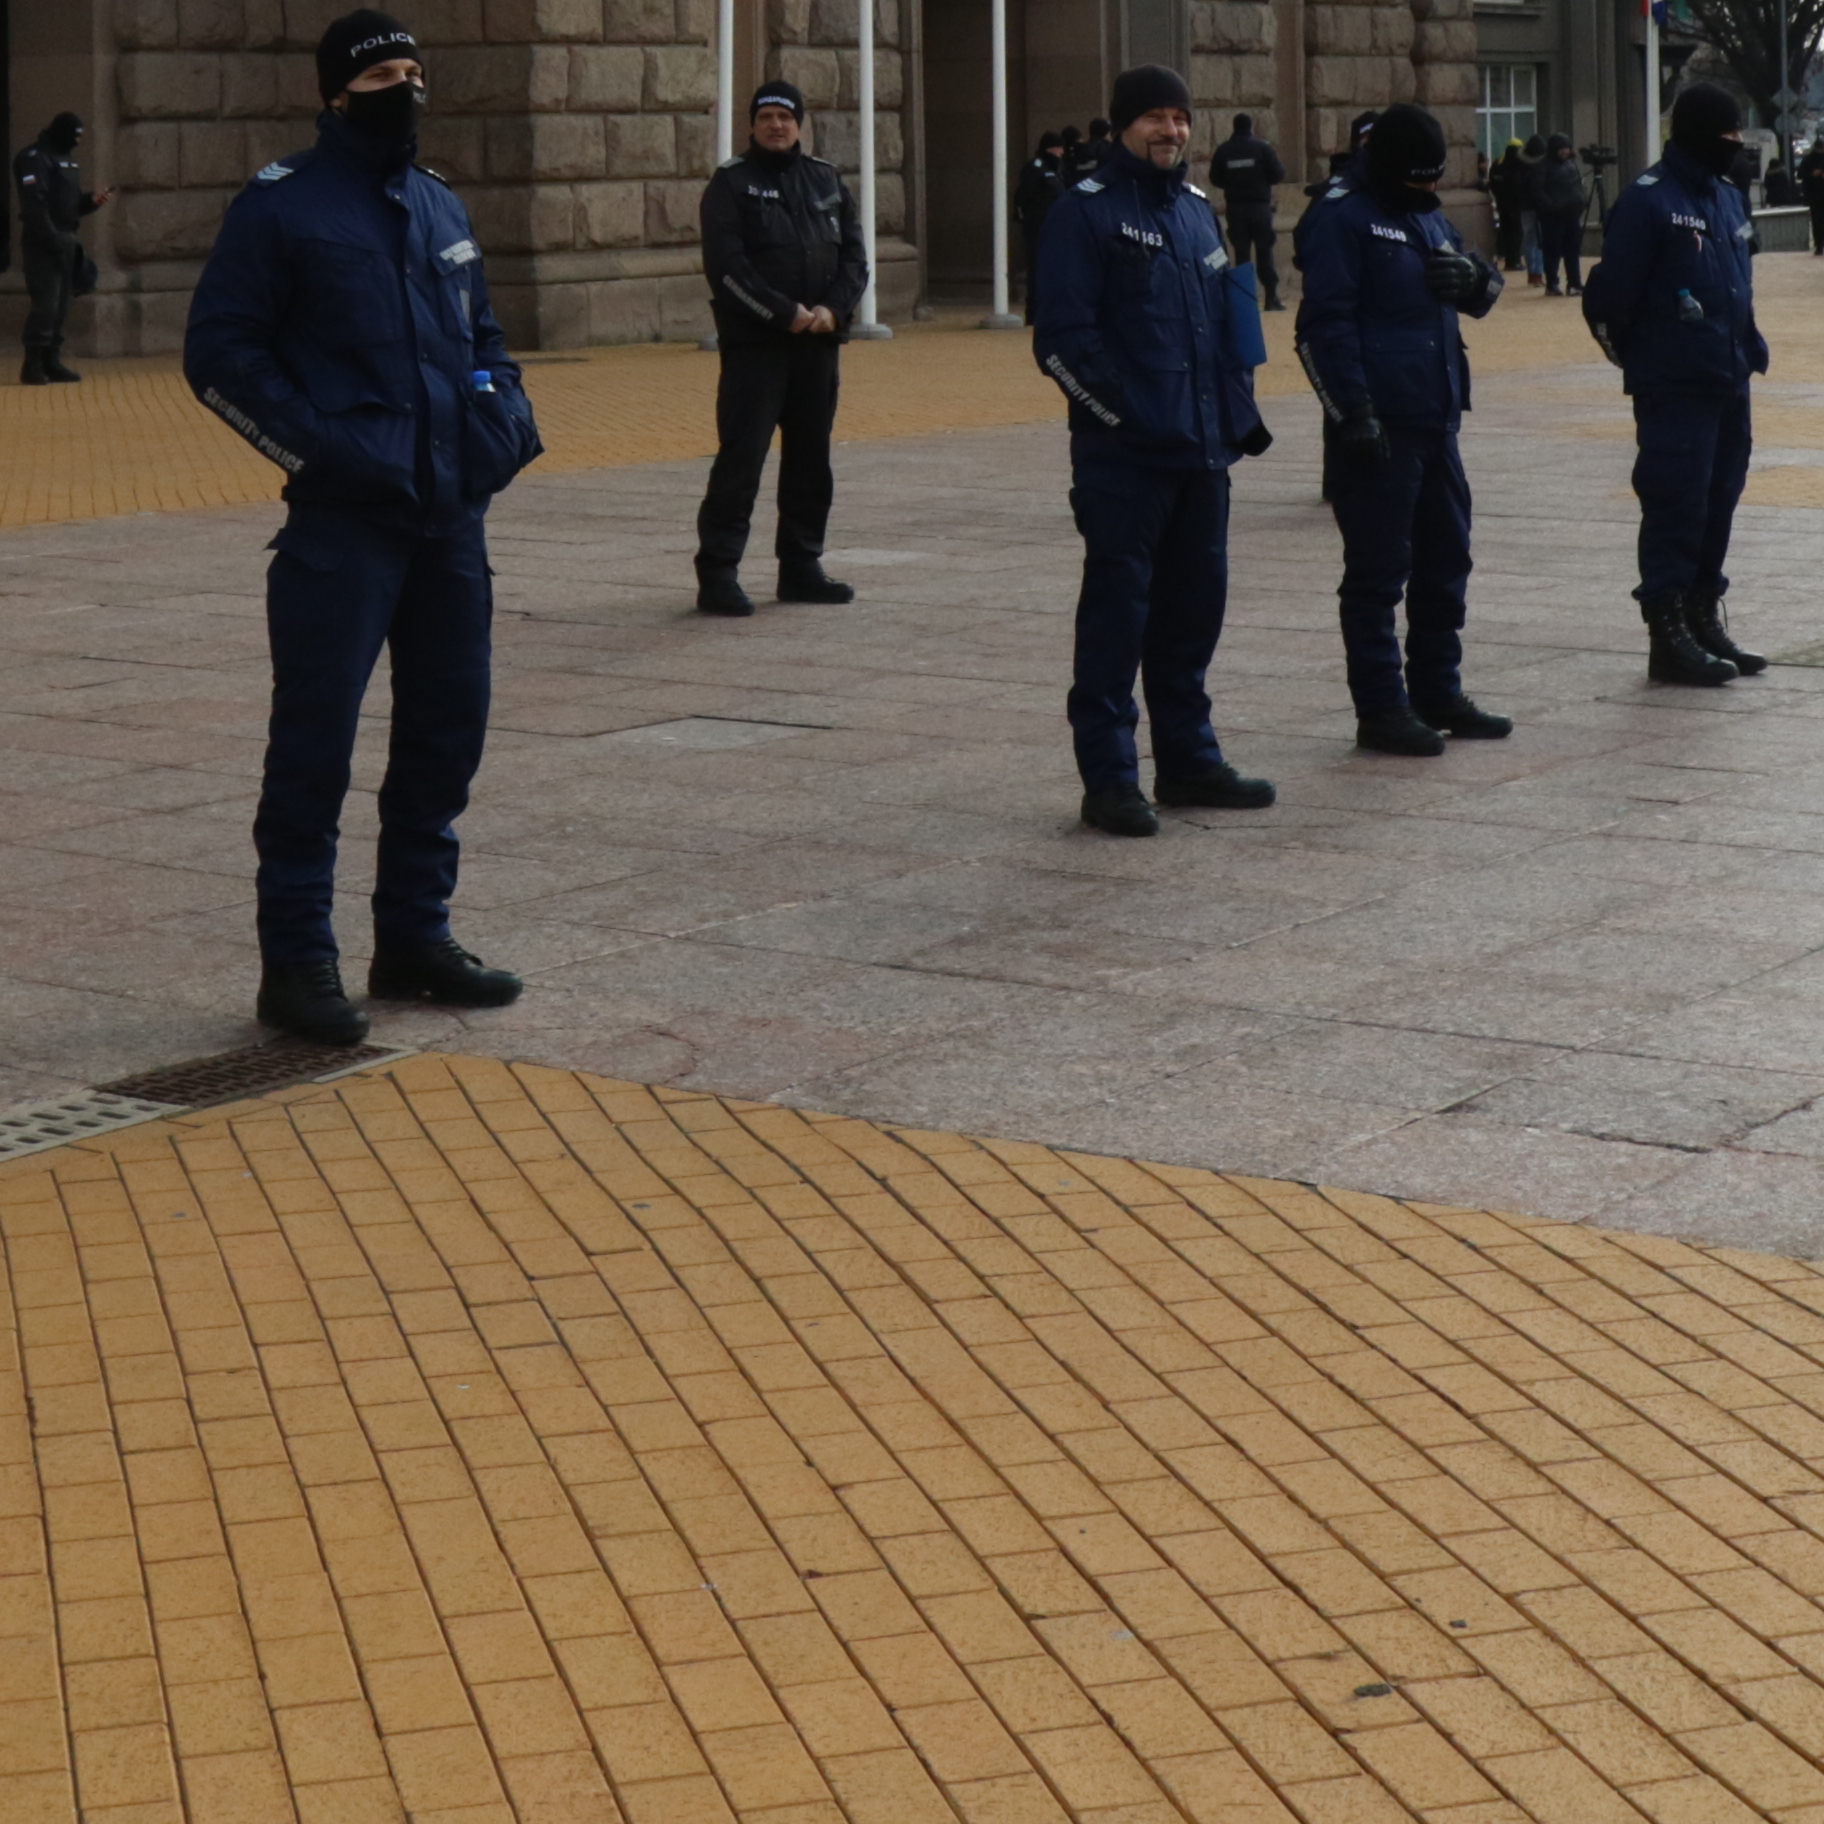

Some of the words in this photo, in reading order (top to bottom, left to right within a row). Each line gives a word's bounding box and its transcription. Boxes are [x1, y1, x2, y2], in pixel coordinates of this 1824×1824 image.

[203, 386, 261, 440] SECURITY
[257, 434, 305, 474] POLICE
[1045, 353, 1091, 402] SECURITY
[1083, 397, 1121, 427] POLICE
